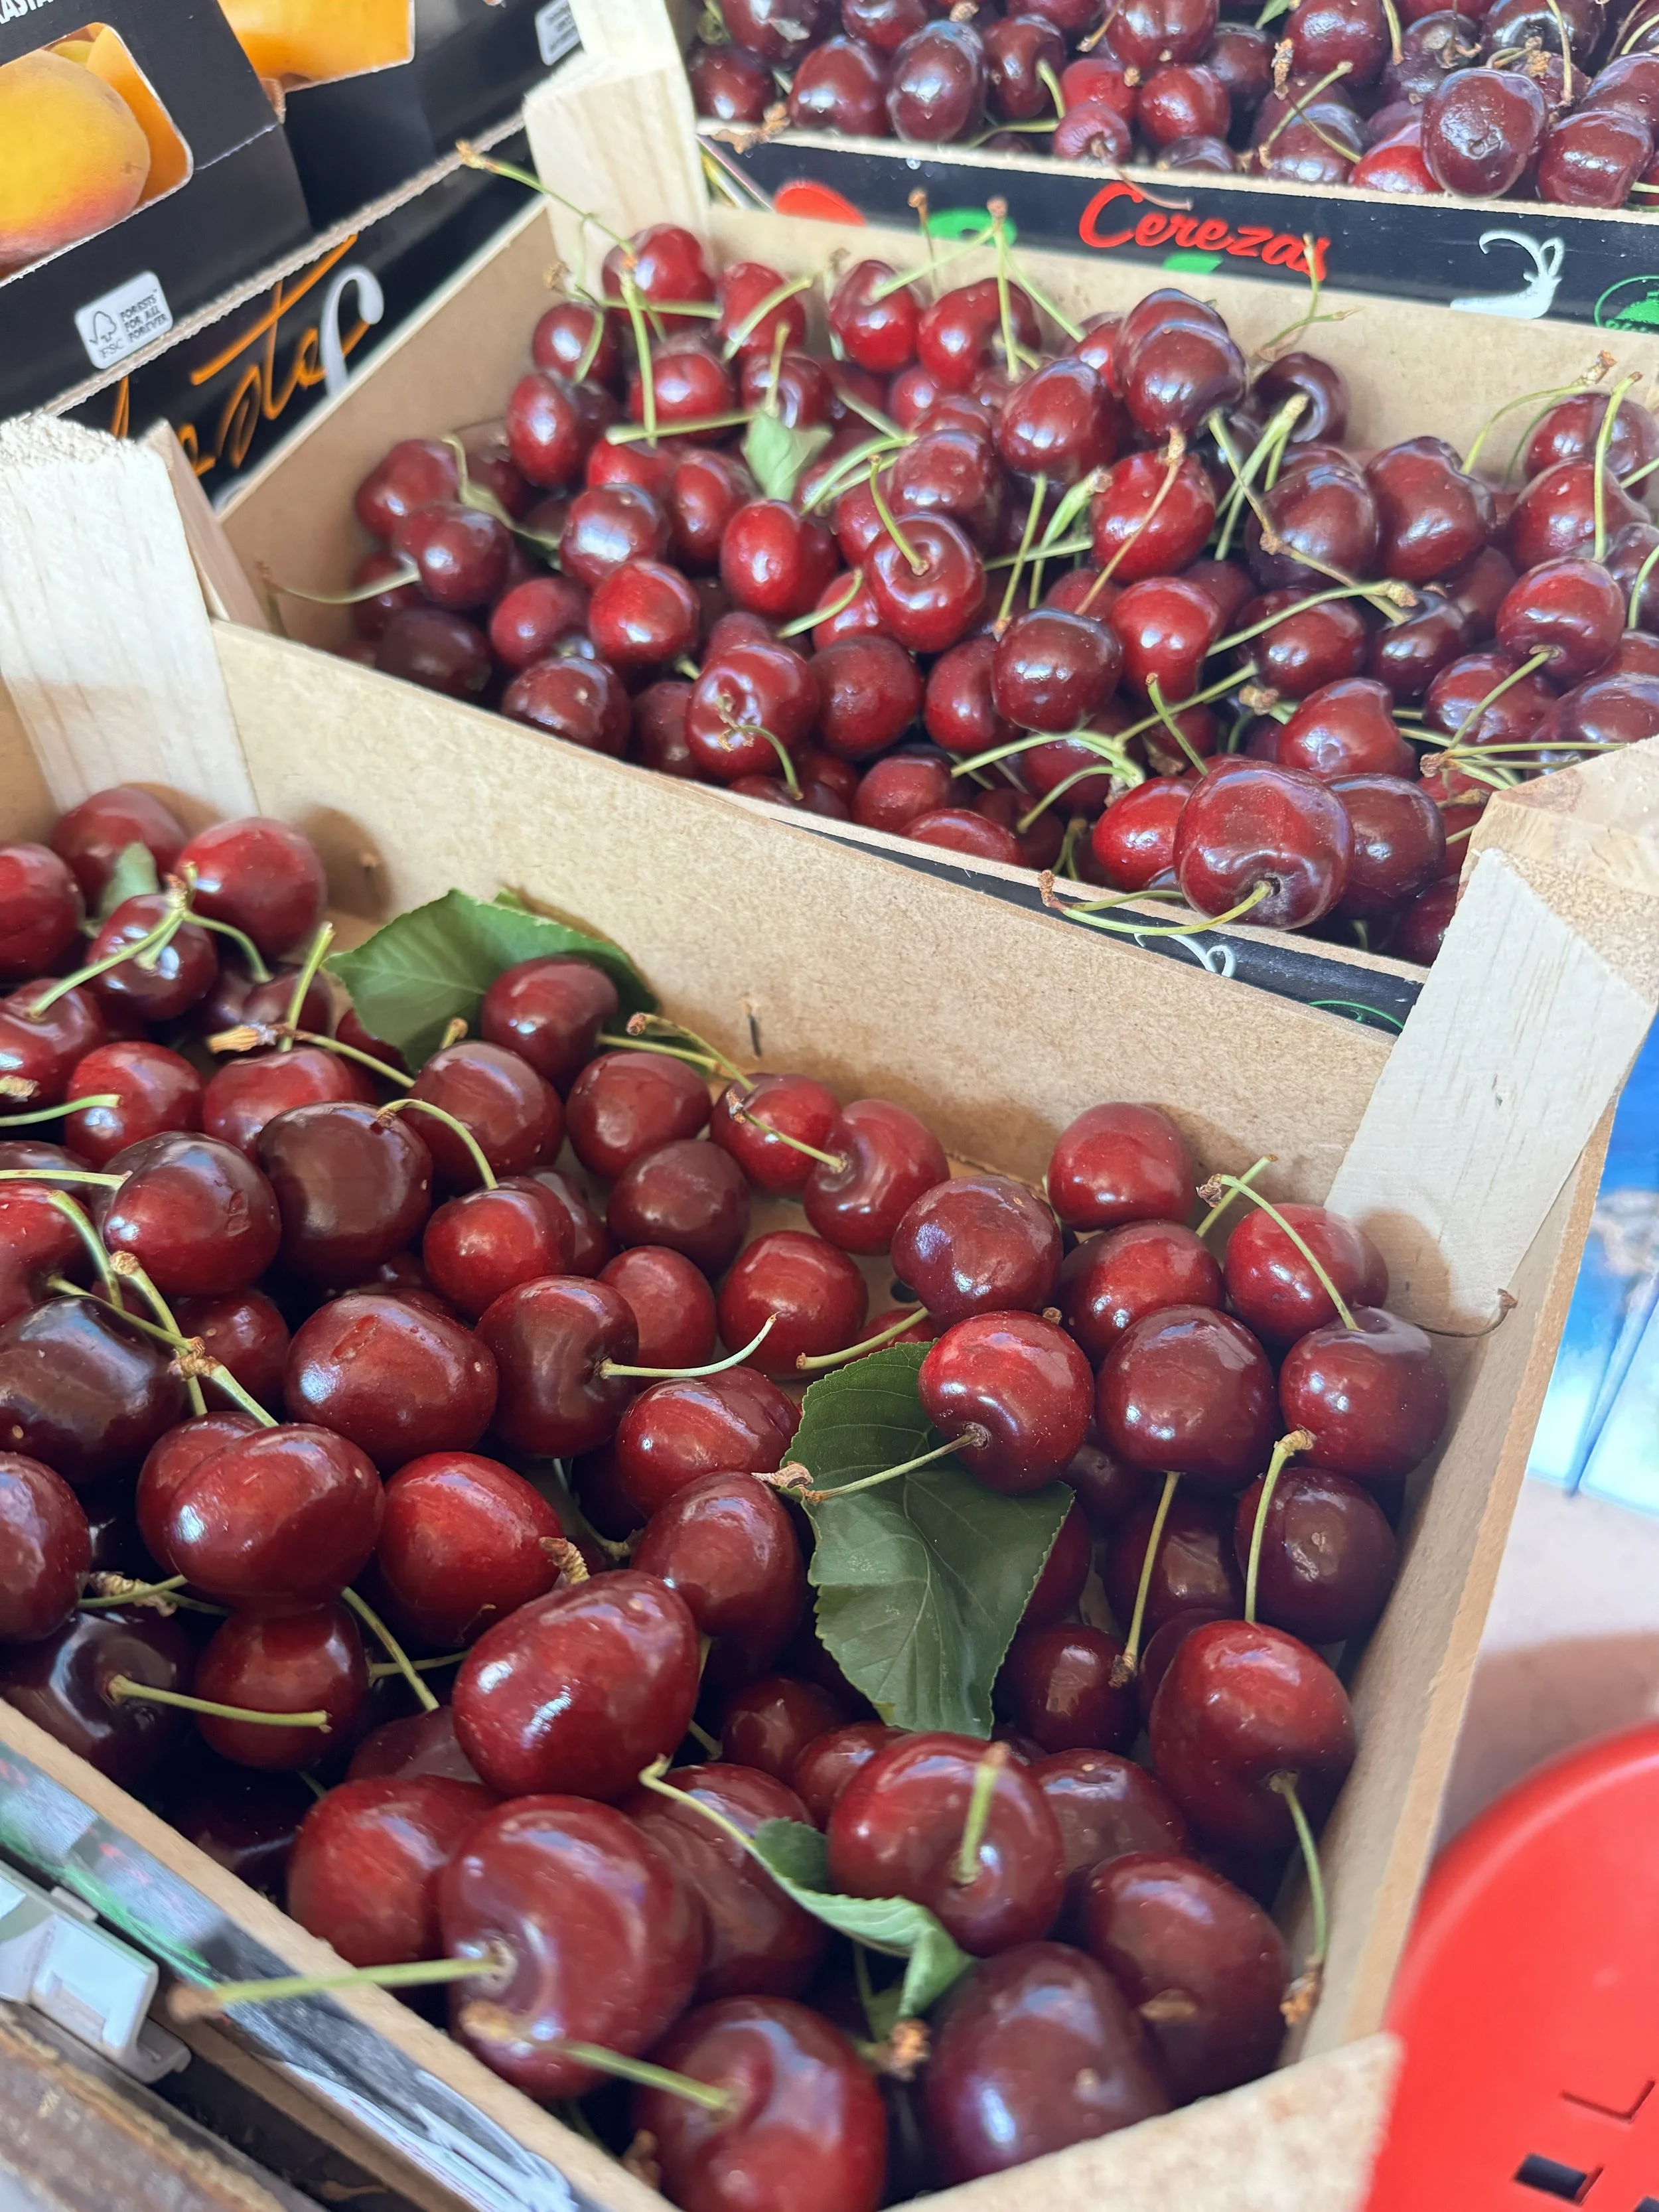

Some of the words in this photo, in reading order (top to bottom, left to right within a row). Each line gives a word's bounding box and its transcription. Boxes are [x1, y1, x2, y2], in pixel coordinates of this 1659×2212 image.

[1078, 182, 1331, 281] Cerezas
[119, 294, 157, 322] FORESTS
[124, 316, 143, 332] FOR
[144, 305, 161, 322] ALL
[127, 314, 169, 343] FOREVER
[100, 338, 125, 358] FSC
